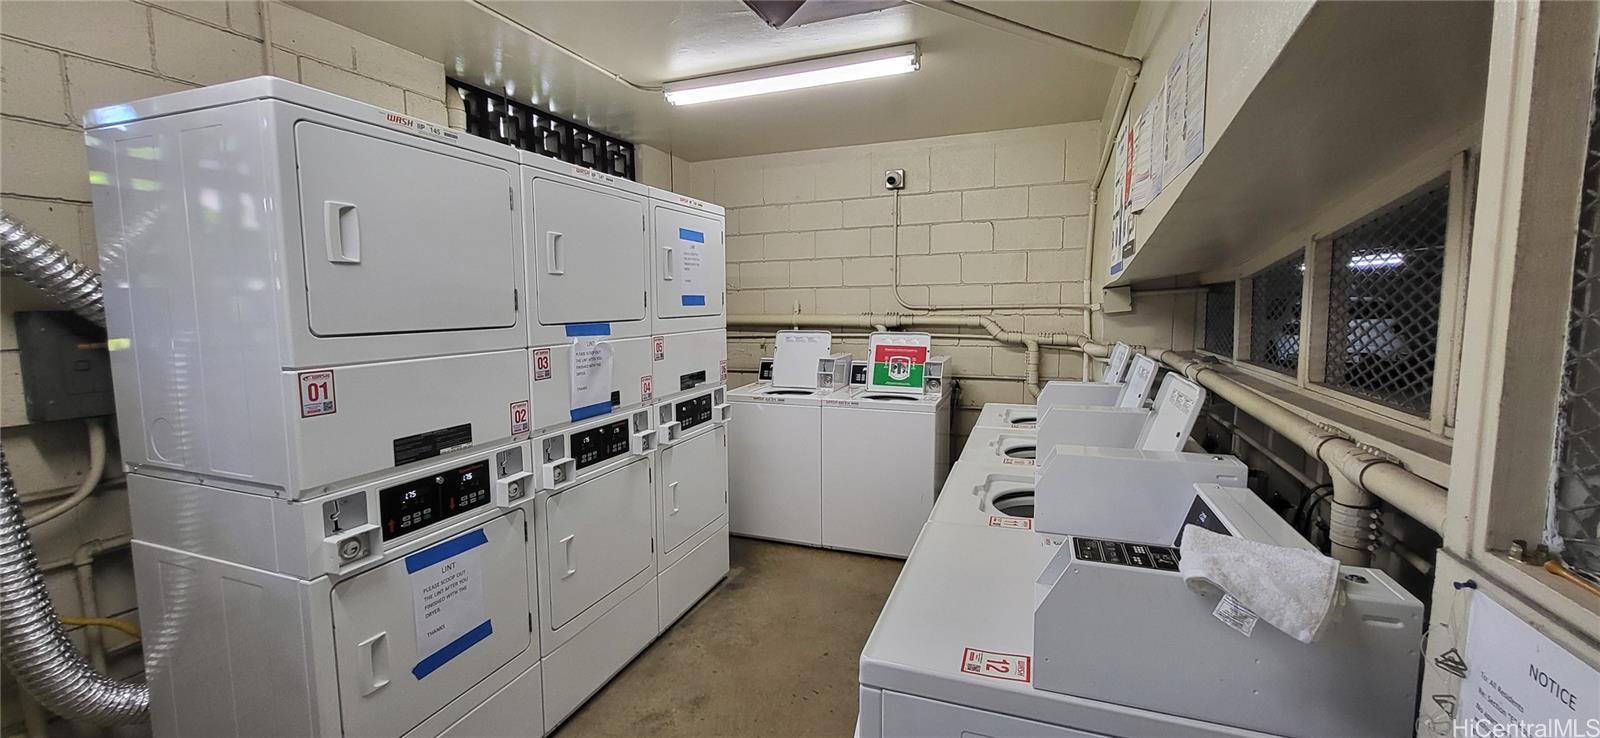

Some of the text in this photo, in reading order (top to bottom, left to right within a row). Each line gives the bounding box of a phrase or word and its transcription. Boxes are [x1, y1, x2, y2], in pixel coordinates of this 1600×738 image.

[387, 113, 413, 127] WASH
[537, 356, 549, 370] 03
[308, 381, 329, 402] 01
[514, 409, 527, 424] 02
[442, 562, 456, 573] LINT
[423, 569, 466, 594] PLEASE SCOOP OUT
[424, 576, 469, 602] THE LINT AFTER YOU
[985, 659, 1010, 674] 12
[1529, 664, 1577, 712] NOTICE
